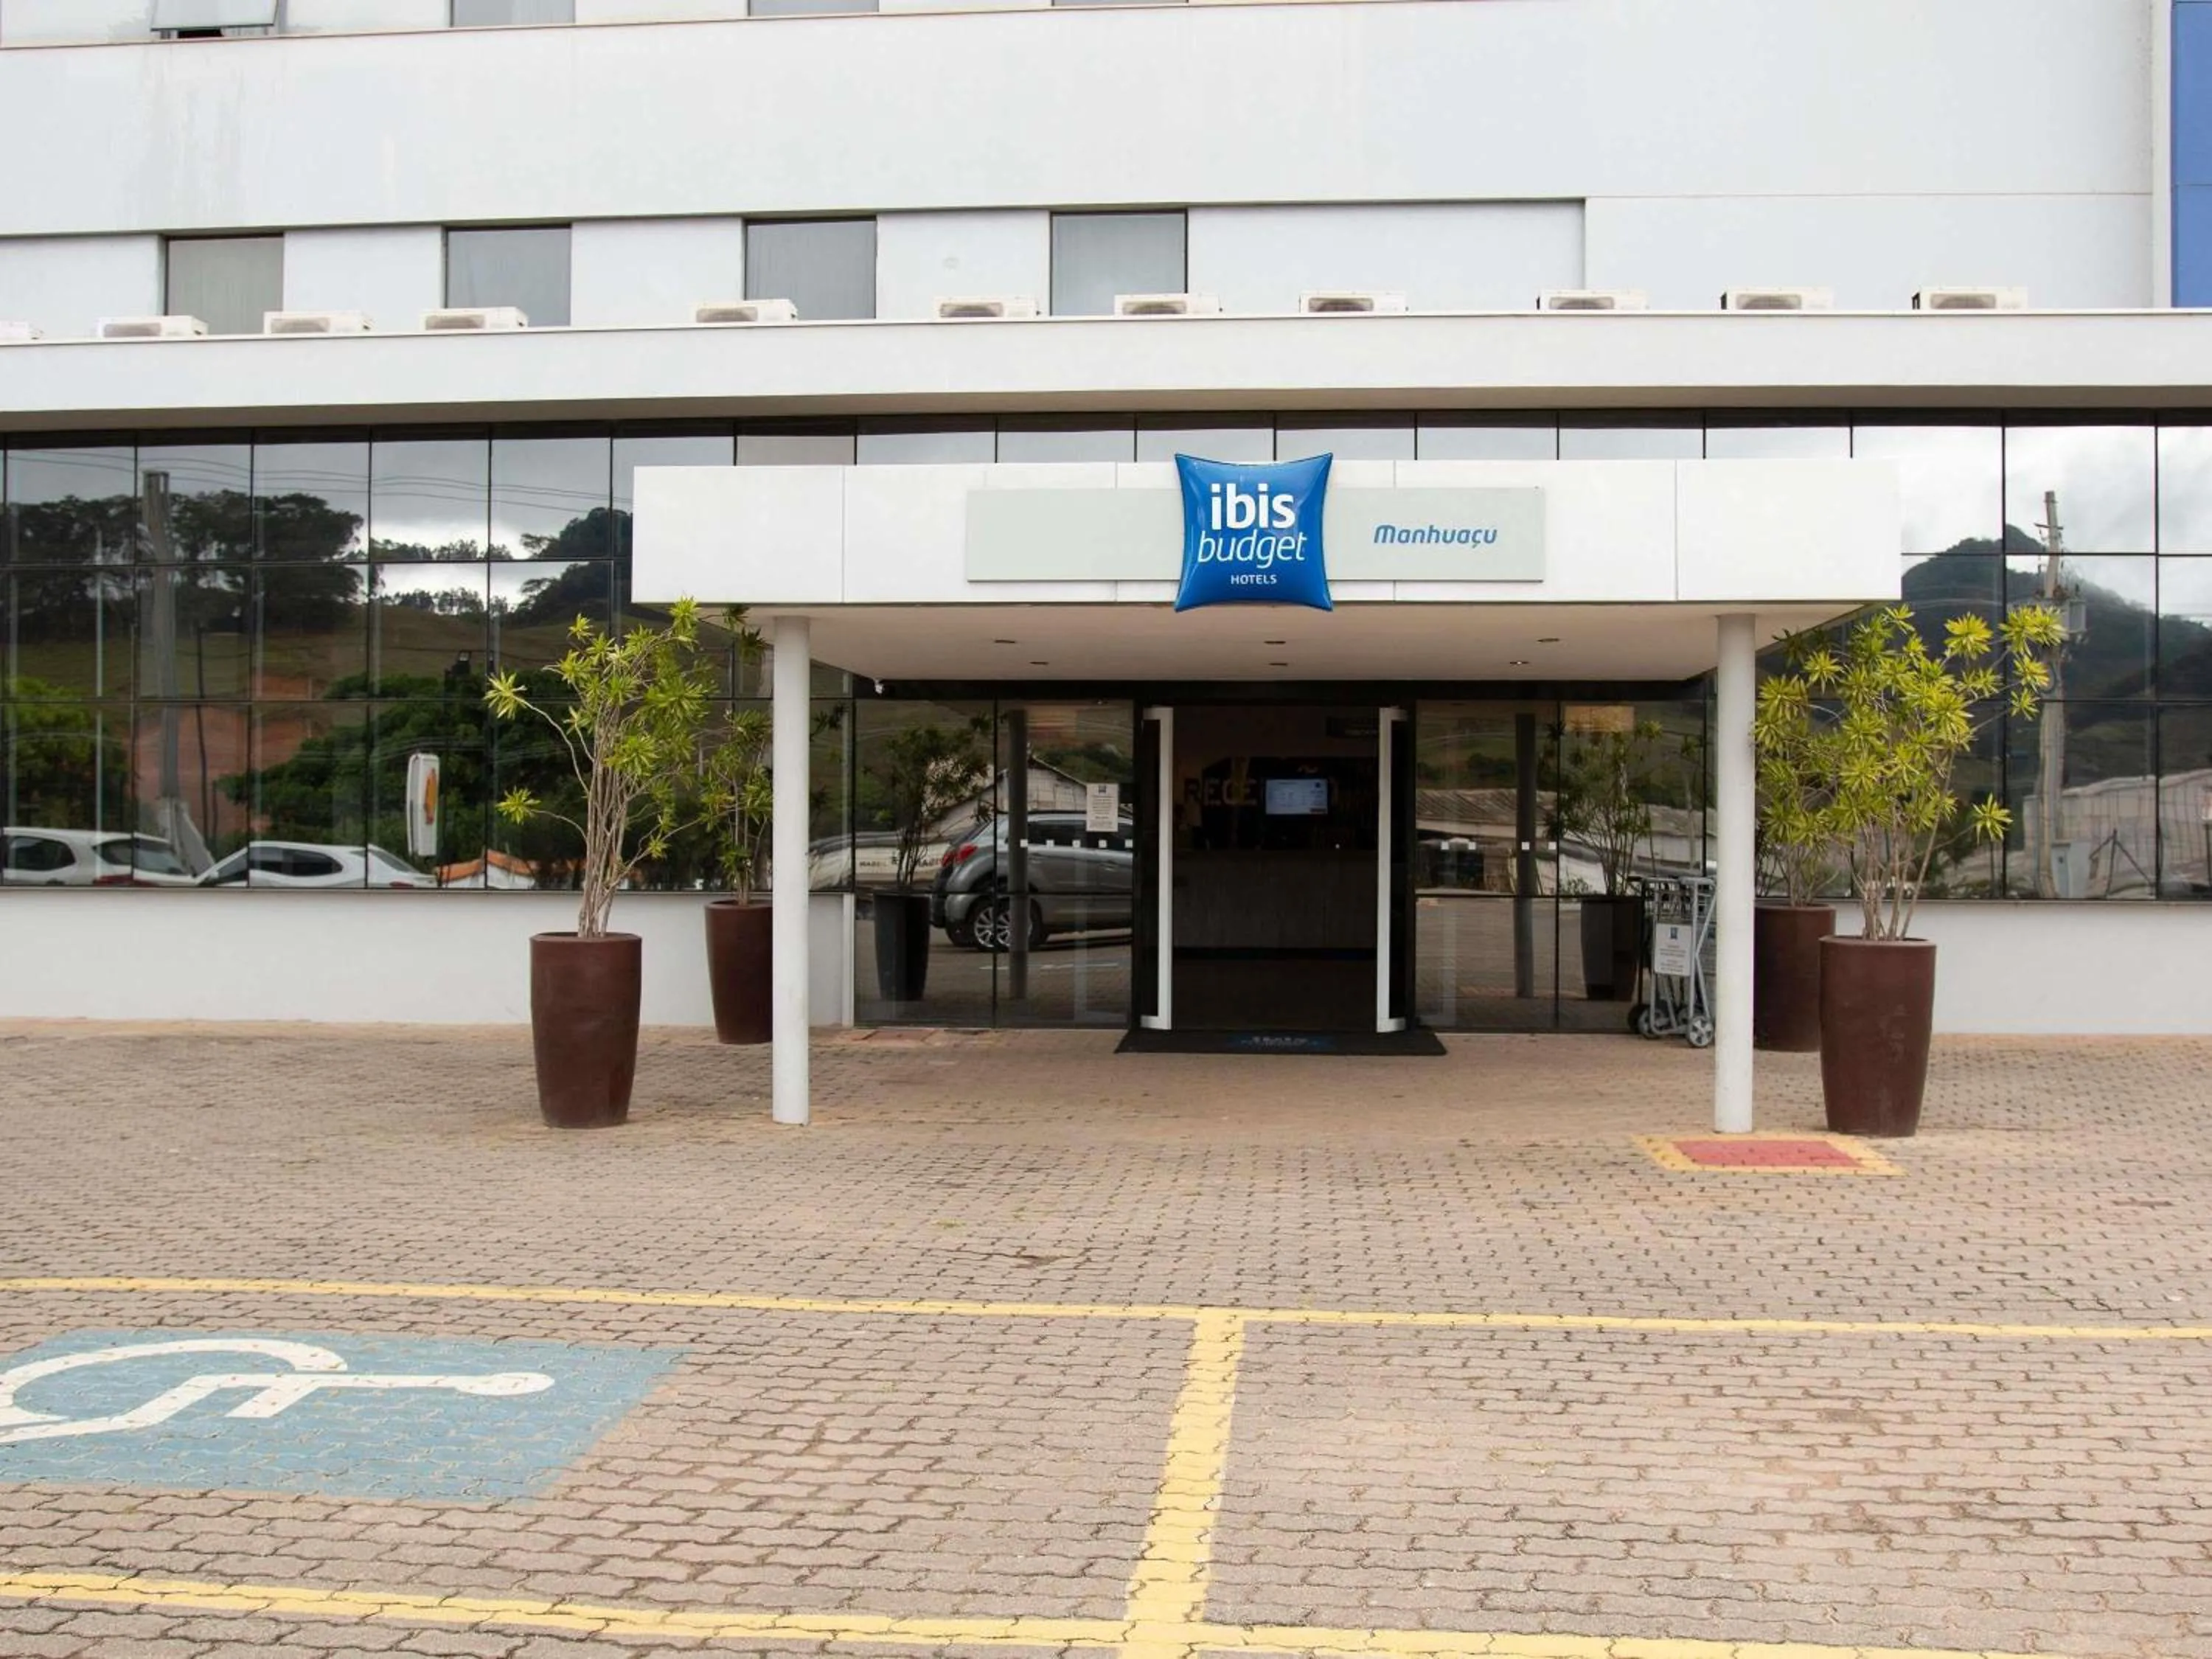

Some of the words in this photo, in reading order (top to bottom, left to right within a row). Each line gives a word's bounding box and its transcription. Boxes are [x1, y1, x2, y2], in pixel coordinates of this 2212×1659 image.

[1211, 483, 1296, 530] ibis
[1197, 529, 1308, 569] budget
[1374, 524, 1498, 549] Manhuaçu
[1231, 574, 1278, 585] HOTELS
